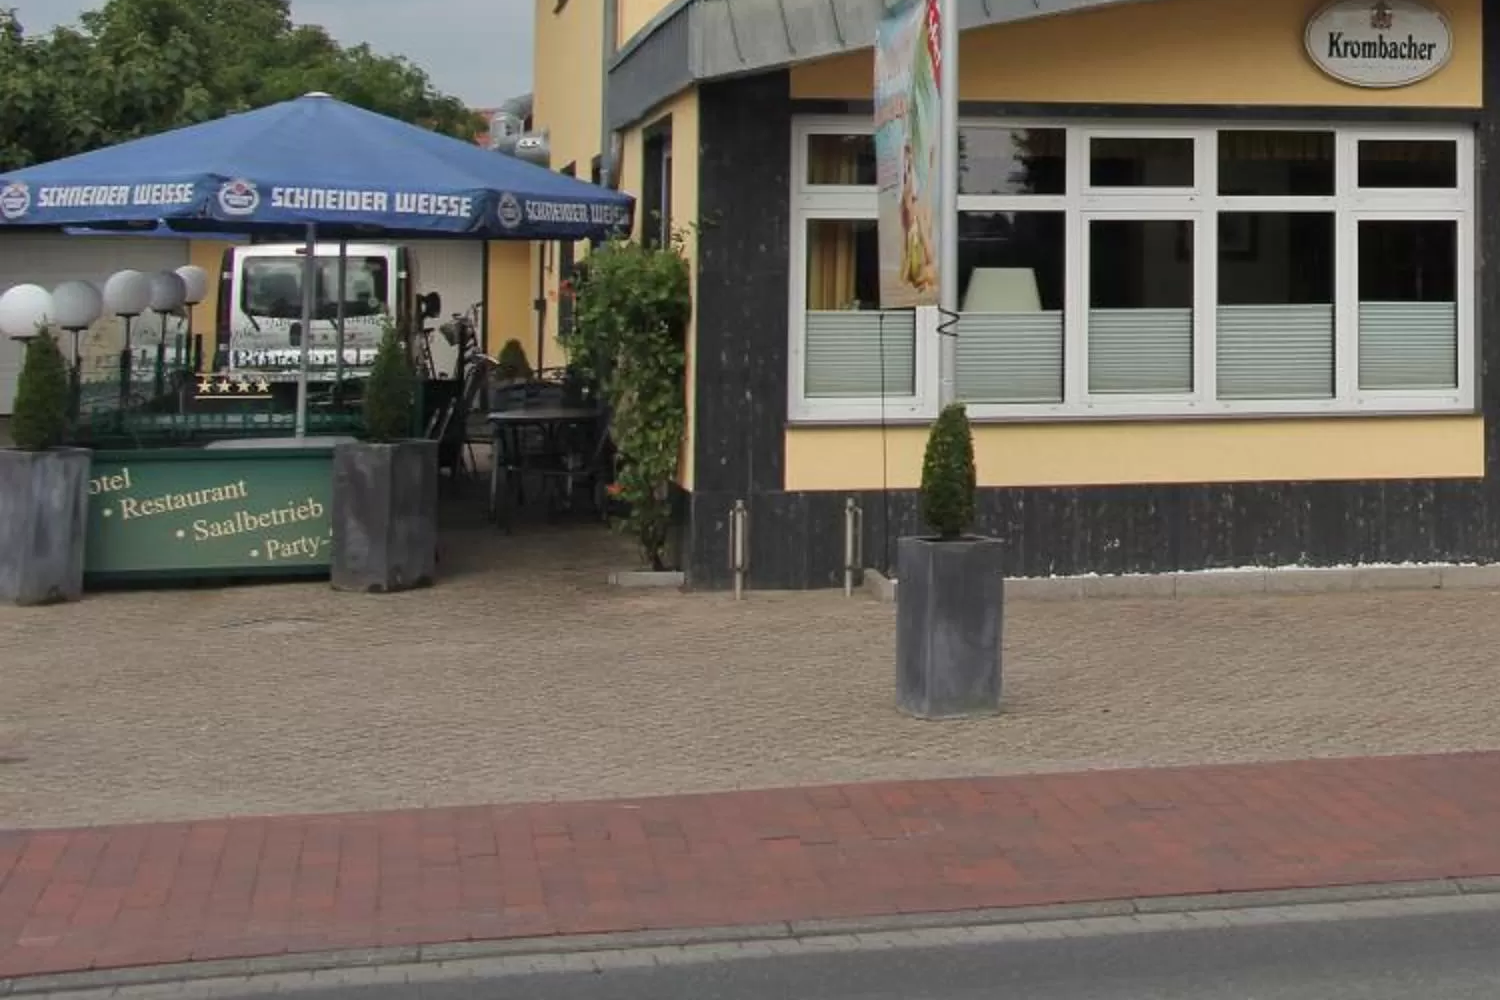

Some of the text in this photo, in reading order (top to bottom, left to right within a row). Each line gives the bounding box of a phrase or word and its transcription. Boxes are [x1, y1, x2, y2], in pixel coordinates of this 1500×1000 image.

[1328, 31, 1437, 61] Krombacher
[37, 183, 195, 207] SCHNEIDER WEISSE
[271, 187, 473, 217] SCHNEIDER WEISSE
[88, 467, 132, 495] otel
[120, 479, 249, 520] Restaurant
[193, 497, 324, 541] Saalbetrieb
[266, 528, 333, 561] Party-
